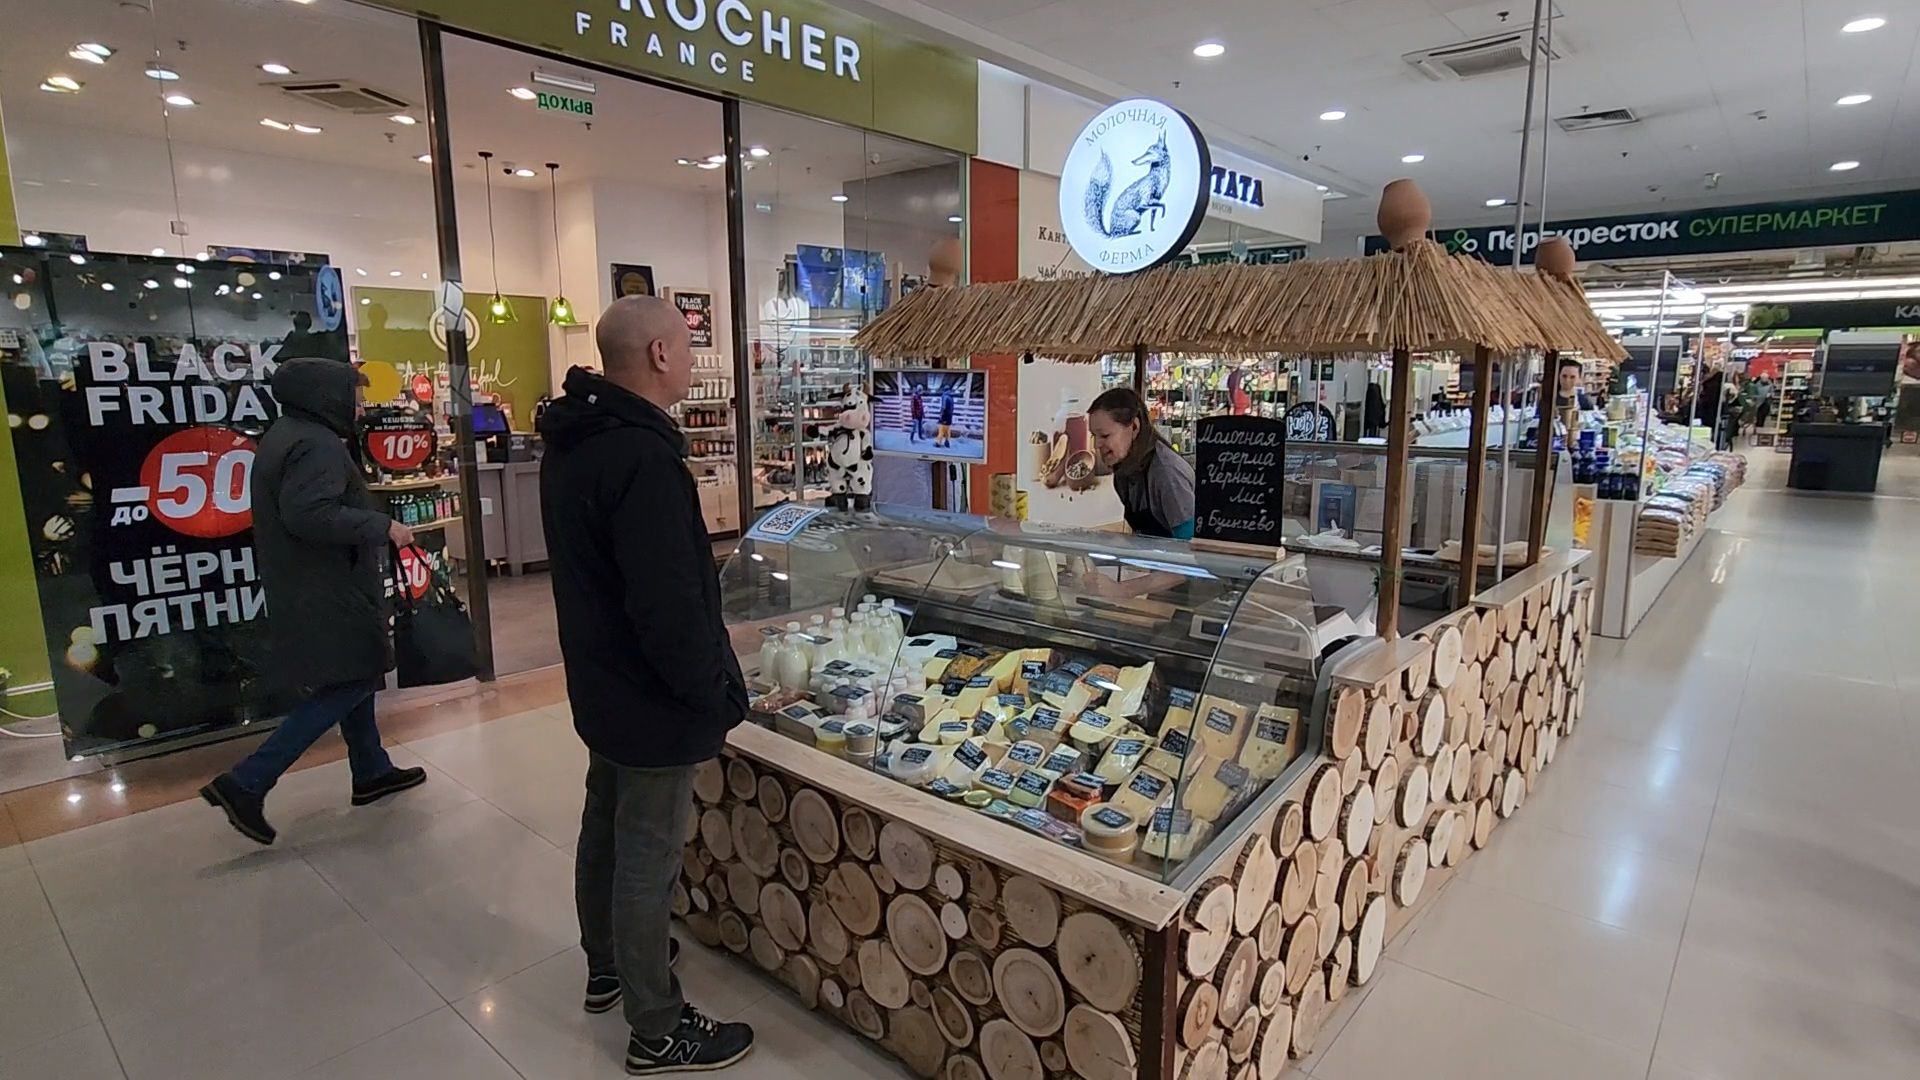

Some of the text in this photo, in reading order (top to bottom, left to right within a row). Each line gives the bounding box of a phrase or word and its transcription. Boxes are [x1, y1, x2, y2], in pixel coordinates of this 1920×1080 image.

[576, 11, 755, 82] FRANCE
[1085, 108, 1168, 147] МОЛОЧНАЯ
[1488, 203, 1888, 255] Перкресток СУПЕРМАРКЕТ
[1099, 243, 1155, 264] ФЕРМА
[87, 341, 284, 382] BLACK
[383, 434, 429, 460] 10%
[1198, 424, 1280, 446] Молочная
[1218, 451, 1276, 470] ферма
[110, 505, 149, 527] до
[109, 545, 261, 597] ЧЁРН
[668, 1039, 701, 1065] N
